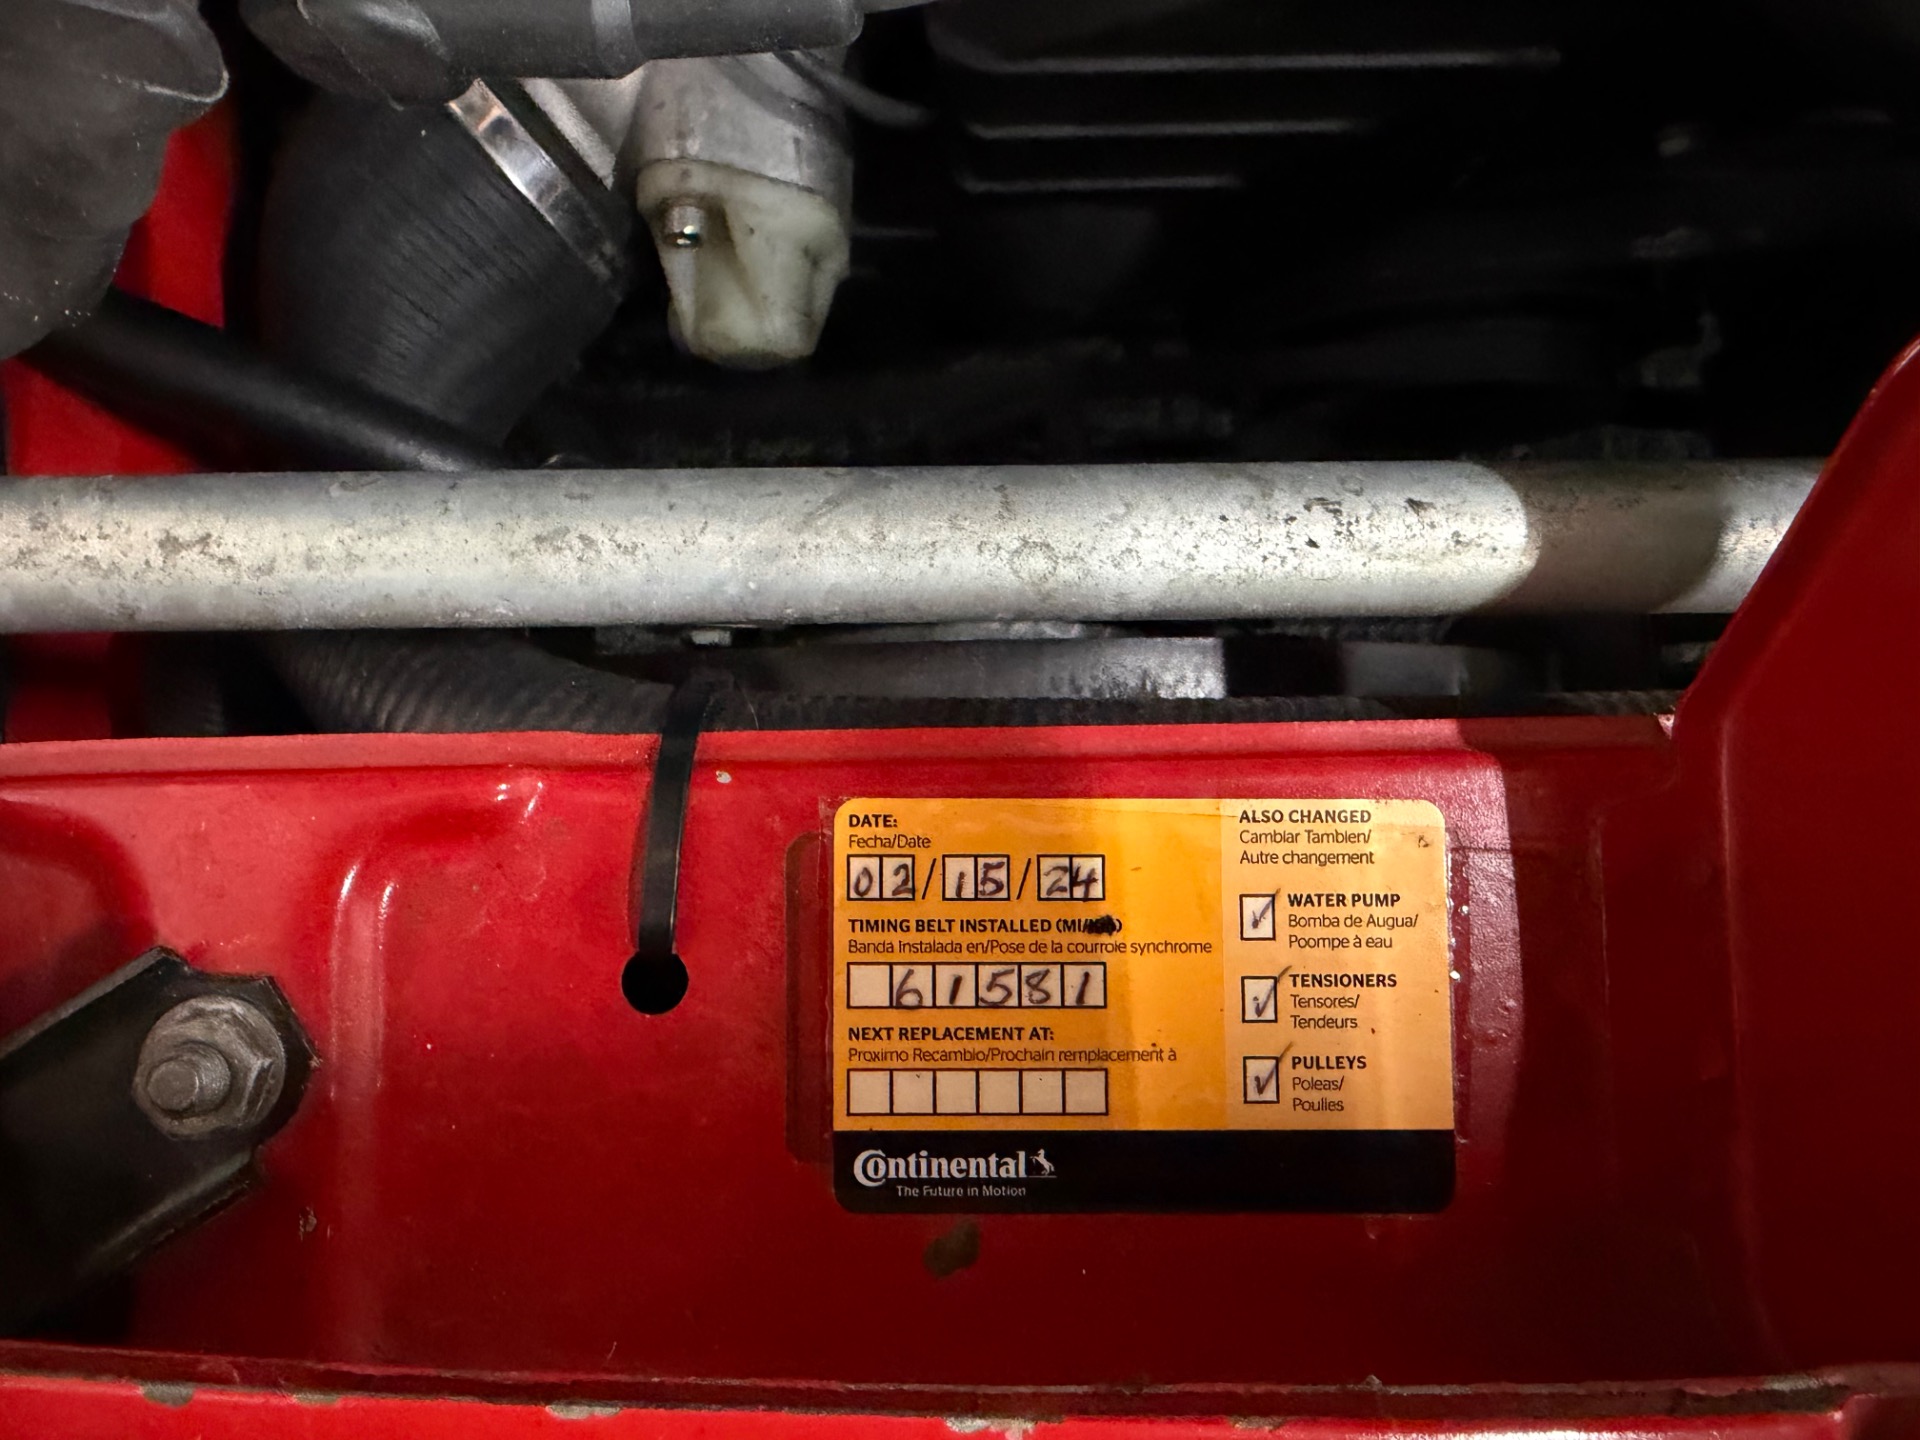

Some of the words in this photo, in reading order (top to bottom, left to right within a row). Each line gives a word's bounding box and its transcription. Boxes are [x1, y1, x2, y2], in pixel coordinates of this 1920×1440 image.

[849, 814, 898, 827] DATE:
[1239, 810, 1284, 823] ALSO
[1288, 810, 1371, 823] CHANGED
[849, 835, 931, 849] Fecha/Date
[1240, 830, 1300, 844] Cambiar
[1305, 830, 1371, 844] Tambien/
[1240, 851, 1279, 864] Autre
[1283, 851, 1374, 867] changement
[1288, 894, 1346, 907] WATER
[1351, 894, 1400, 907] PUMP
[849, 919, 910, 933] TIMING
[916, 919, 953, 933] BELT
[960, 919, 1051, 933] INSTALLED
[1288, 915, 1339, 928] Bomba
[1344, 915, 1362, 928] de
[1367, 914, 1418, 930] Augua/
[849, 941, 894, 954] Banda
[966, 941, 1024, 954] en/Pose
[1029, 941, 1047, 954] de
[1051, 941, 1062, 954] la
[1067, 941, 1127, 954] courroie
[1131, 941, 1212, 956] synchrome
[1289, 935, 1349, 951] Poompe
[1354, 935, 1361, 948] à
[1366, 938, 1392, 948] eau
[897, 968, 1090, 1006] 61581
[1290, 974, 1397, 987] TENSIONERS
[1291, 995, 1359, 1009] Tensores/
[1291, 1015, 1358, 1028] Tendeurs
[849, 1028, 893, 1041] NEXT
[899, 1028, 1024, 1041] REPLACEMENT
[1029, 1028, 1054, 1041] AT:
[849, 1048, 908, 1063] Proximo
[1059, 1048, 1163, 1064] remplacement
[1168, 1048, 1176, 1061] à
[1292, 1056, 1367, 1069] PULLEYS
[1292, 1077, 1344, 1091] Poleas/
[1293, 1098, 1344, 1111] Poulies
[854, 1149, 1026, 1186] Continental
[896, 1185, 919, 1196] The
[923, 1185, 963, 1196] Future
[967, 1185, 978, 1196] in
[983, 1185, 1025, 1196] Motion
